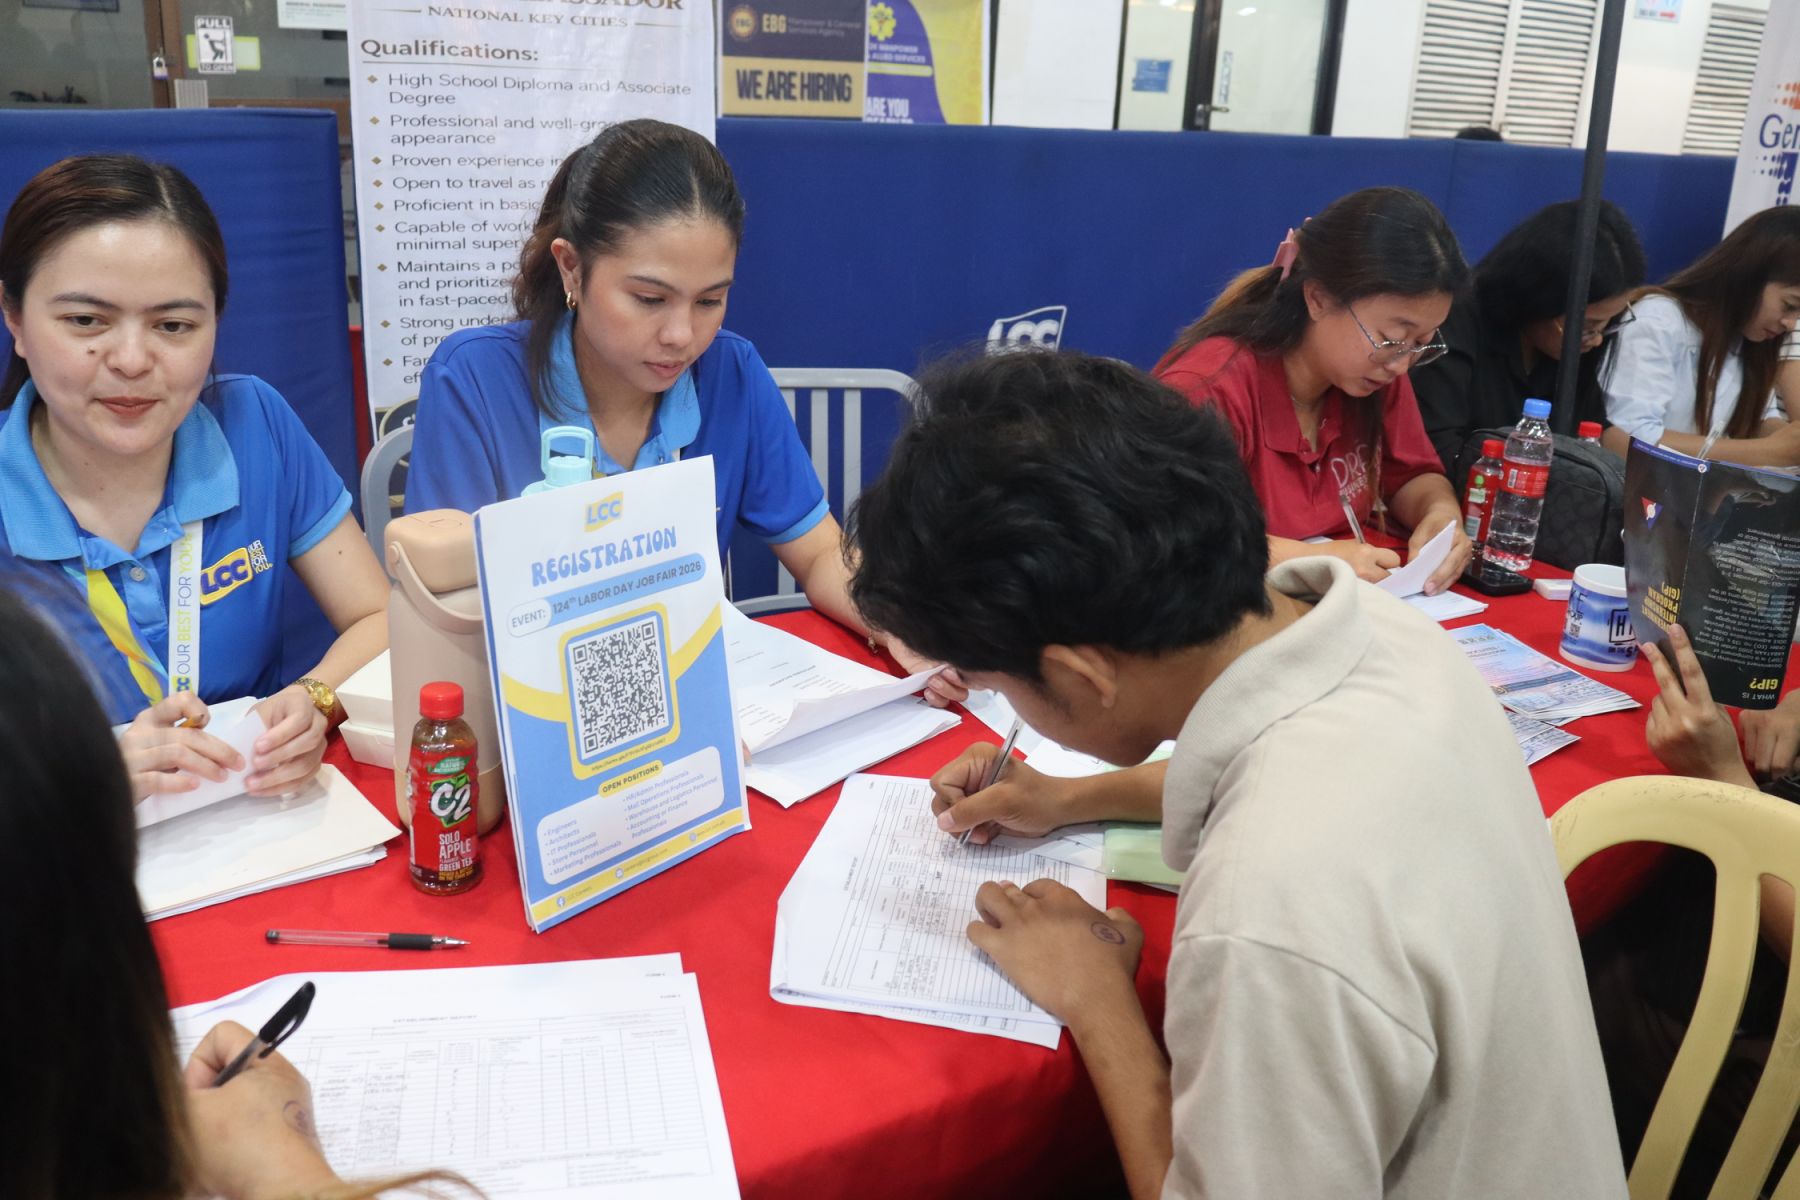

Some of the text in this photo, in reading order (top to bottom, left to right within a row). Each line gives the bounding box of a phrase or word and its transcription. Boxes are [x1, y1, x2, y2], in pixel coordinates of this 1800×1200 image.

[197, 18, 231, 28] PULL
[428, 6, 628, 27] NATIONAL KEY CITIES
[762, 14, 787, 33] EBG
[361, 39, 539, 62] Qualifications:
[201, 63, 234, 71] TO OPEN
[388, 73, 692, 96] High School Diploma and Associate
[736, 69, 853, 102] WE ARE HIRING
[389, 91, 456, 107] Degree
[887, 98, 910, 118] YOU
[390, 114, 612, 132] Professional and well-gro
[390, 132, 496, 147] appearance
[391, 154, 451, 167] Proven
[457, 155, 545, 170] experience
[392, 177, 440, 192] Open
[446, 177, 463, 189] to
[469, 176, 513, 189] travel
[518, 180, 535, 189] as
[394, 198, 541, 212] Proficient in basic
[395, 220, 533, 235] Capable of work
[396, 237, 520, 251] minimal super
[397, 260, 480, 273] Maintains
[486, 262, 496, 271] a
[398, 277, 430, 290] and
[399, 292, 509, 308] in fast-paced
[400, 314, 505, 330] Strong under
[401, 333, 418, 346] of
[986, 319, 1060, 356] LCC
[585, 500, 621, 525] LCC
[531, 526, 677, 588] REGISTRATION
[201, 559, 247, 596] LCC
[178, 577, 192, 607] FOR
[512, 608, 546, 628] EVENT:
[578, 587, 612, 607] LABOR
[613, 581, 634, 596] DAY
[636, 575, 655, 589] JOB
[656, 568, 677, 582] FAIR
[679, 561, 702, 577] 2026
[1648, 586, 1678, 614] PROGRAM
[1661, 581, 1680, 600] (GIP)
[177, 610, 191, 642] BEST
[1642, 604, 1670, 635] OVERNMENT
[177, 644, 191, 675] OUR
[1749, 678, 1778, 690] GIP?
[602, 765, 660, 793] OPEN POSITIONS
[431, 783, 472, 820] C2
[438, 830, 460, 845] SOLO
[439, 838, 472, 859] APPLE
[439, 861, 461, 872] GREEN
[461, 857, 473, 867] TEA
